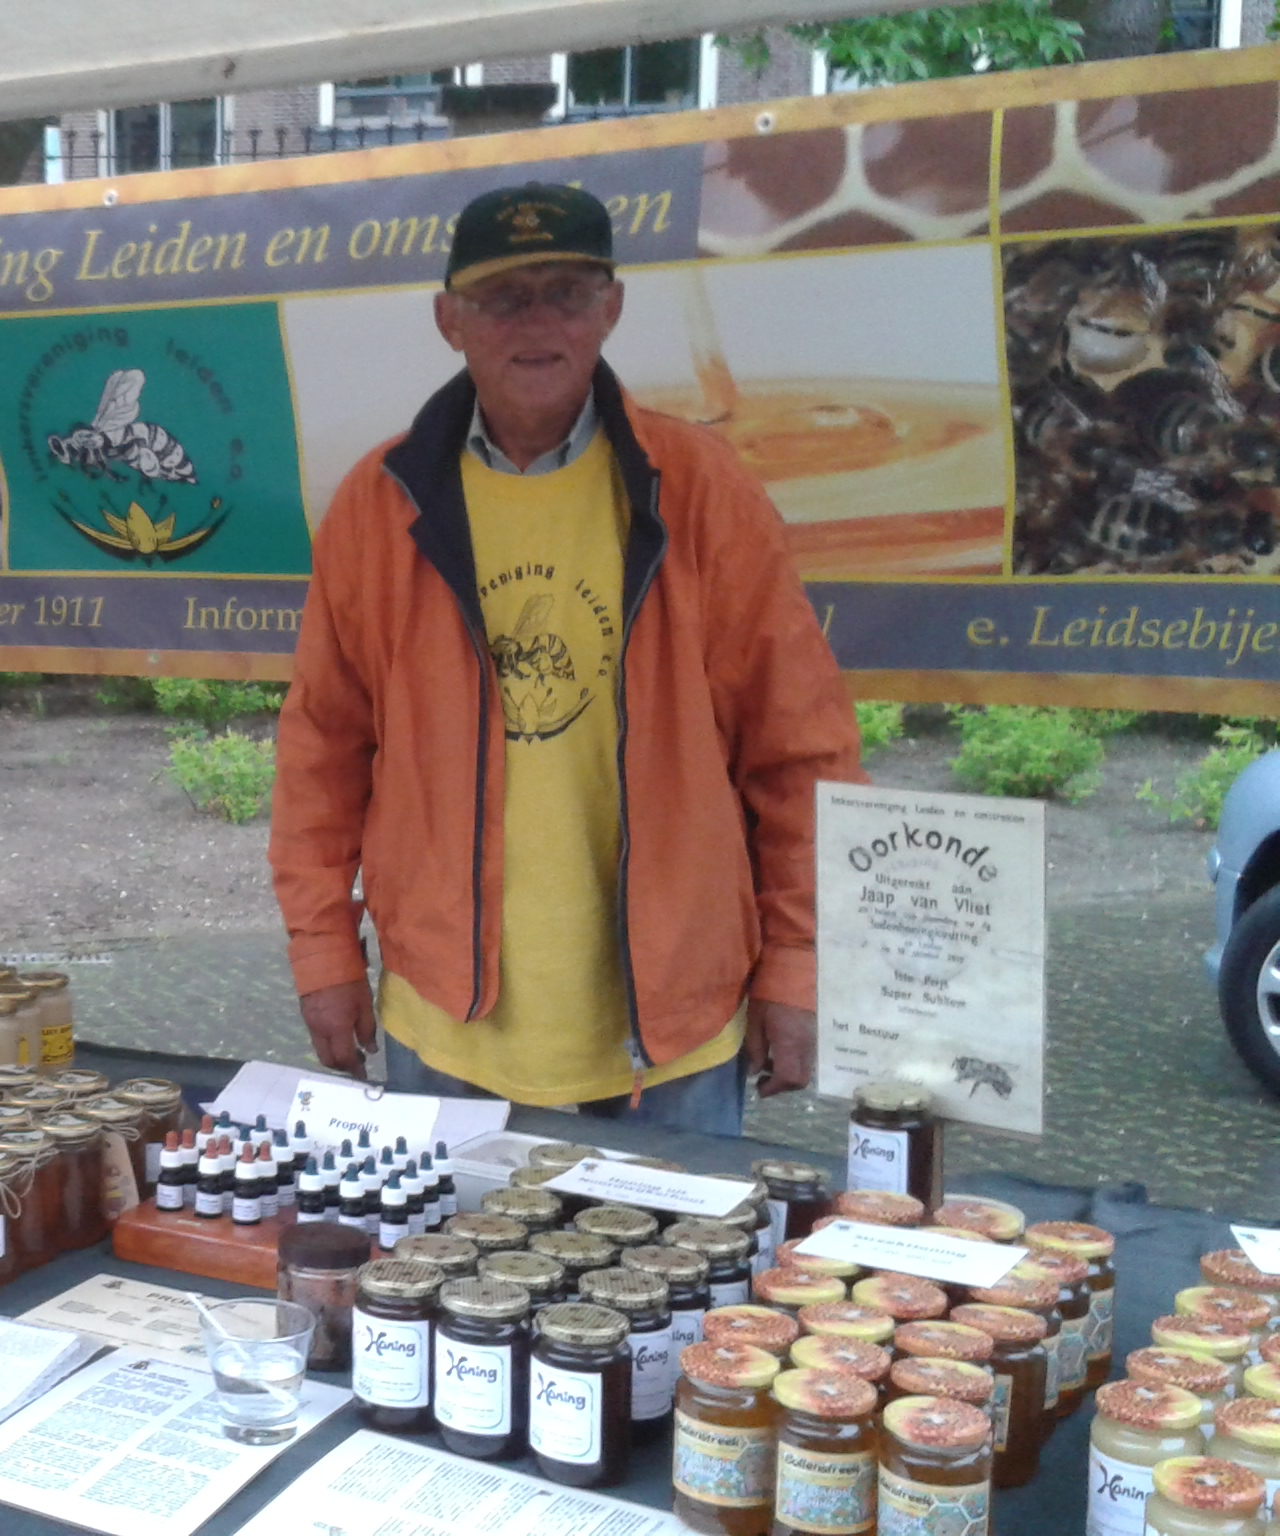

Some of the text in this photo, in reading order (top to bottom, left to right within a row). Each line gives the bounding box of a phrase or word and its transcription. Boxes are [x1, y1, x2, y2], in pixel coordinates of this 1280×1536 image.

[76, 220, 247, 281] Leiden
[265, 222, 331, 267] en
[34, 596, 106, 627] 1911
[575, 579, 614, 637] leiden
[1028, 605, 1280, 666] Leidsebije
[848, 822, 998, 882] Oorkonde
[860, 885, 991, 916] Jaap van Vliet
[329, 1117, 379, 1135] Propolis
